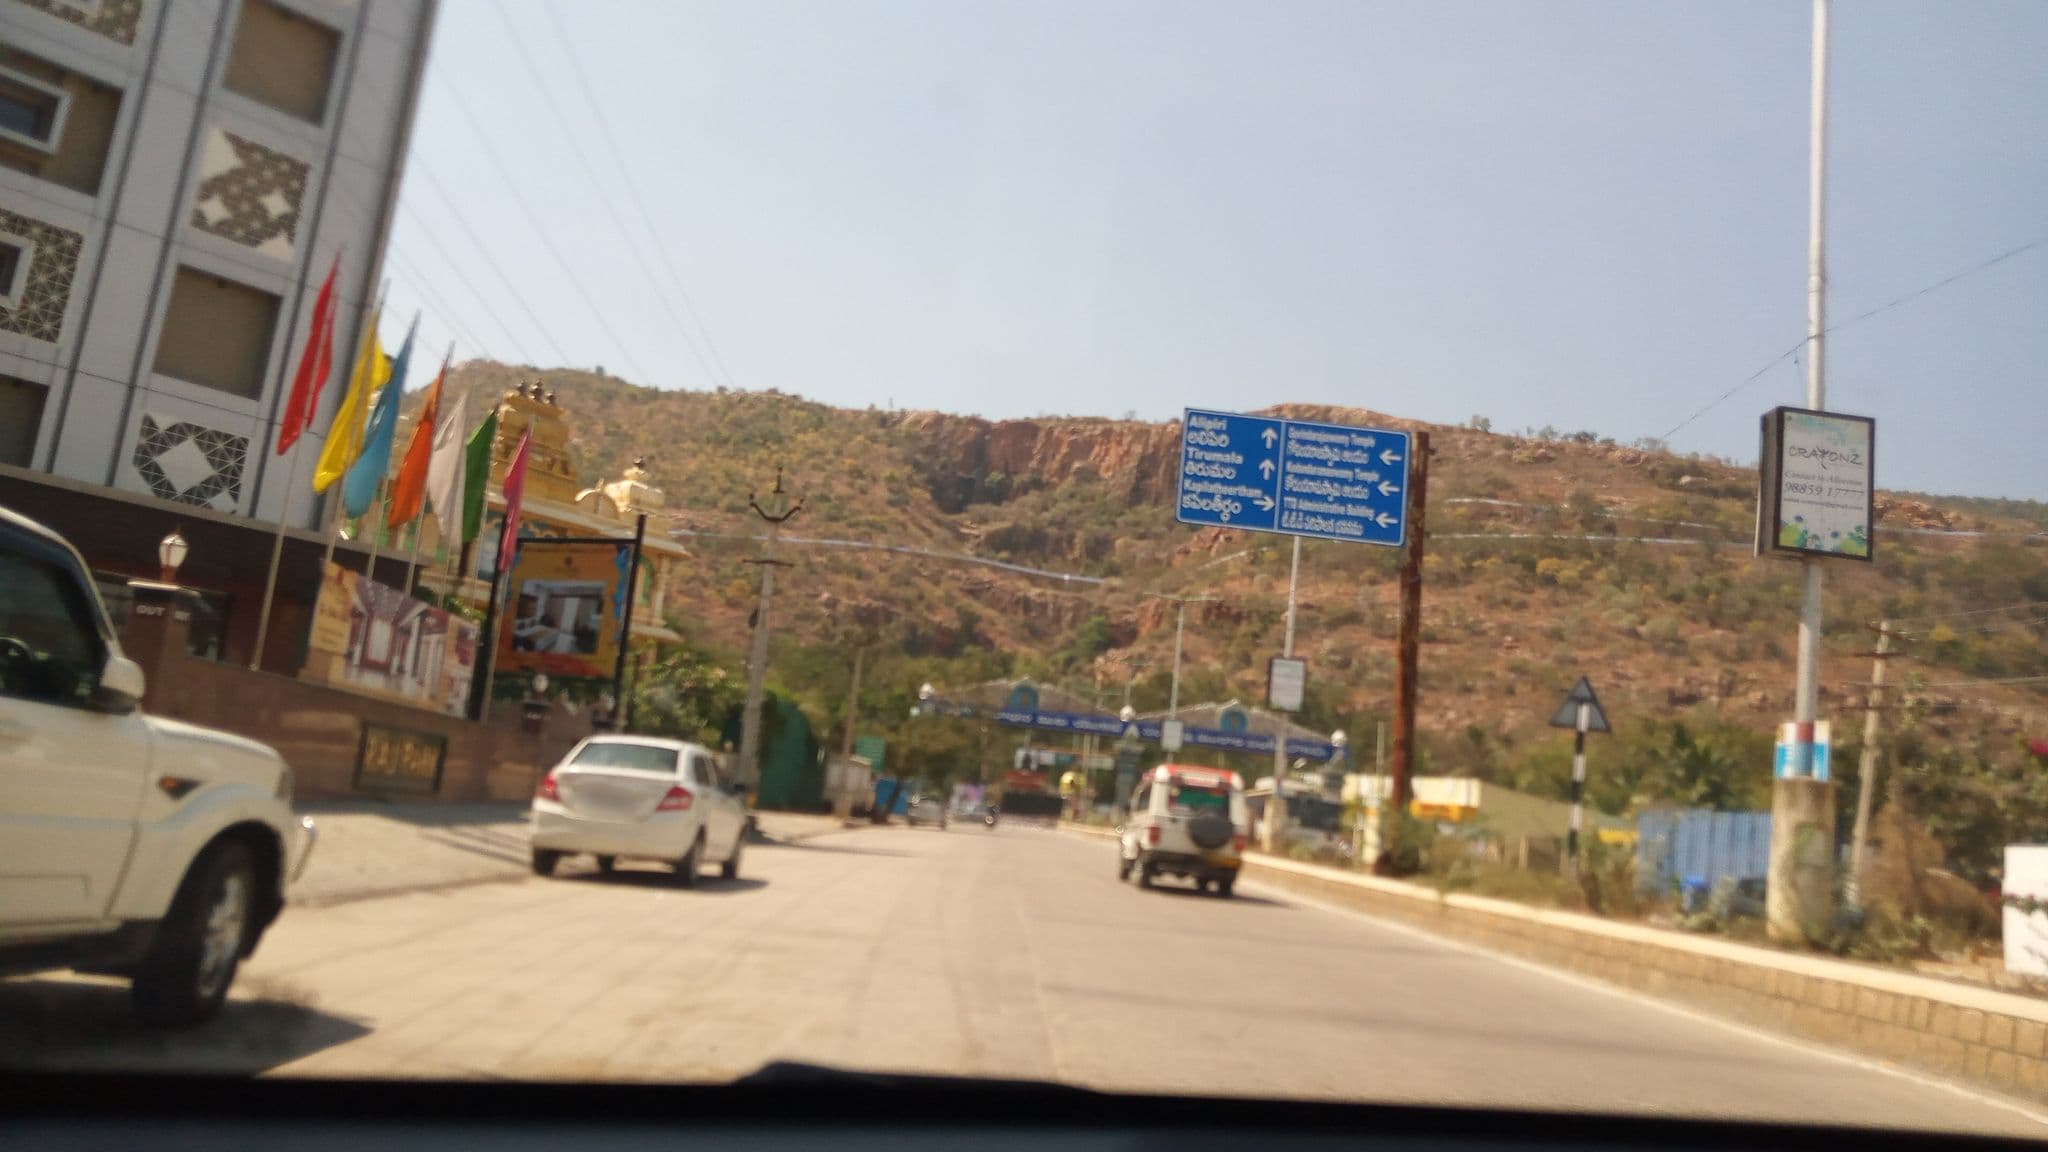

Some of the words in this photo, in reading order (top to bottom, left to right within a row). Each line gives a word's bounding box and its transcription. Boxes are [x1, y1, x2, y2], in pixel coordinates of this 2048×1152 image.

[1190, 415, 1227, 431] Alipiri
[1188, 431, 1229, 448] అలిపిరి
[1187, 448, 1243, 464] Tirumala
[1185, 461, 1236, 480] తిరుమల
[1784, 482, 1823, 496] 98859
[136, 604, 166, 616] OUT
